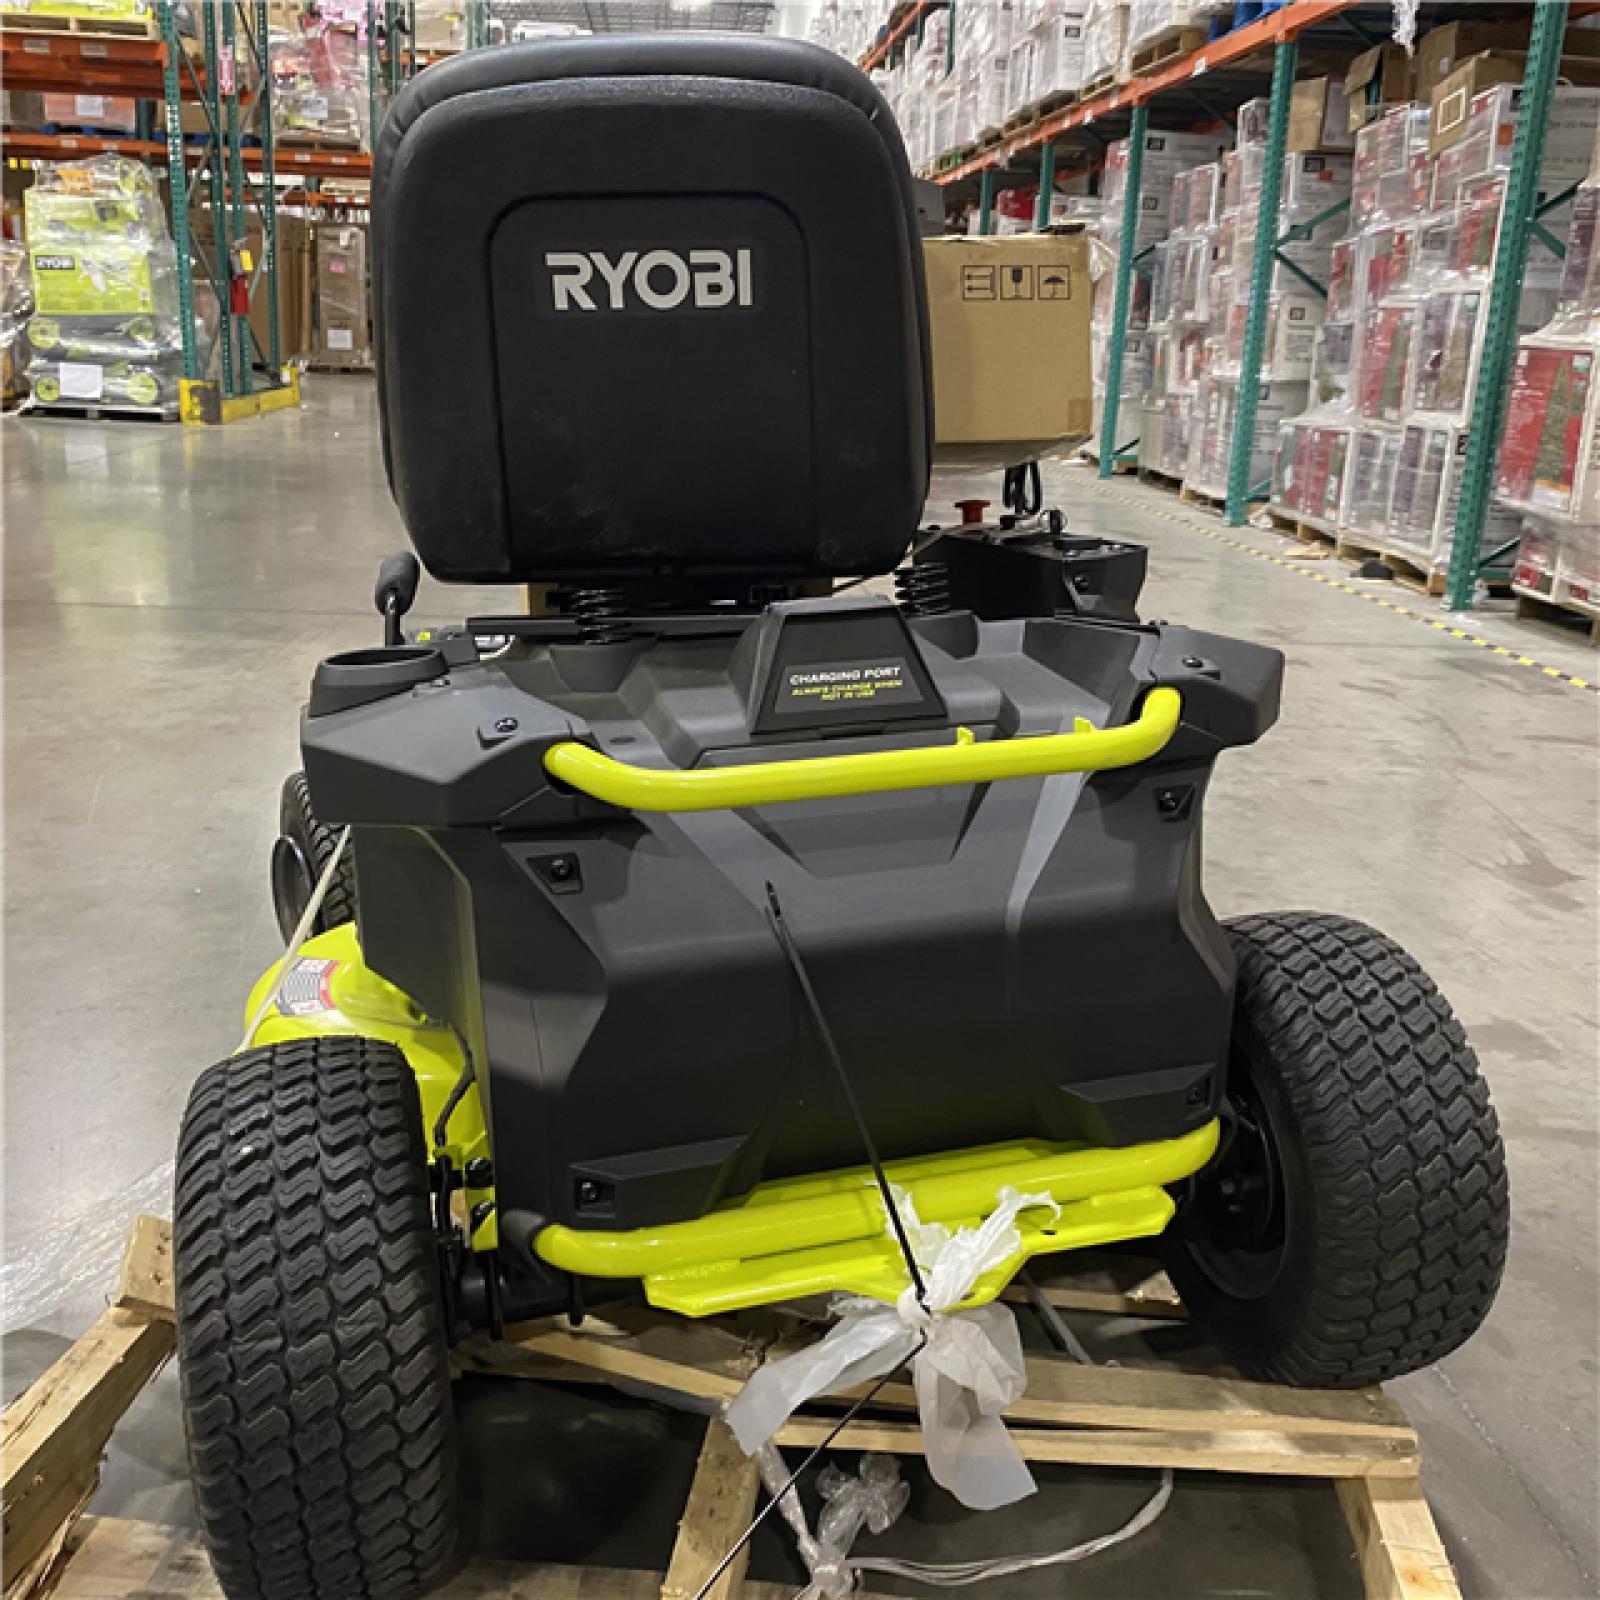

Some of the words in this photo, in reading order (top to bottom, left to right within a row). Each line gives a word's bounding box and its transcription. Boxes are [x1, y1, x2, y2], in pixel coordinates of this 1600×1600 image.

[545, 248, 753, 311] RYOBI
[790, 670, 861, 685] CHARGING
[864, 665, 901, 678] PORT
